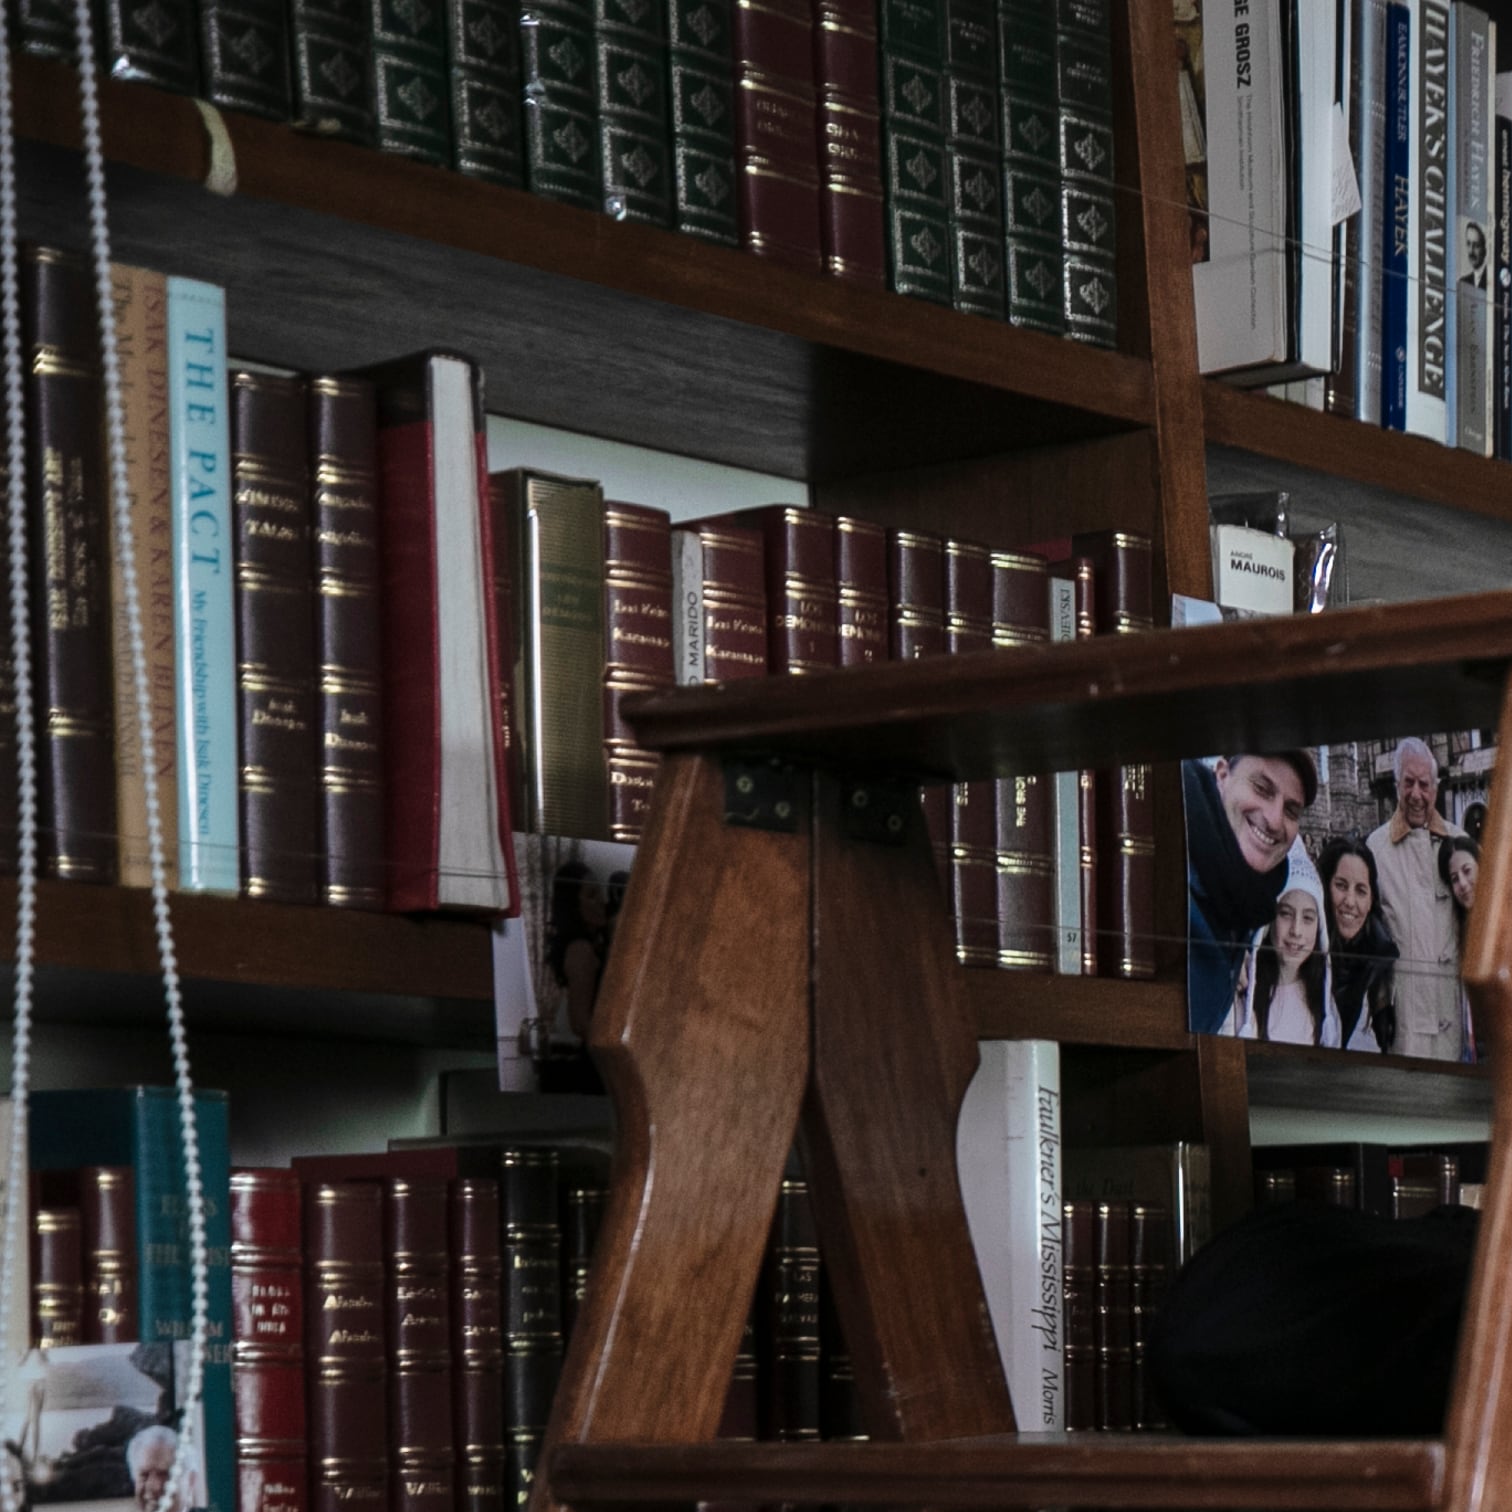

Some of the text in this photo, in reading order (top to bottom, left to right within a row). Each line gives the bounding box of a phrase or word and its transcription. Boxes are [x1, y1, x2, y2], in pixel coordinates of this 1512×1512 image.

[1235, 24, 1252, 89] GROSZ
[1470, 30, 1485, 210] FRIEDRICH HAYEK
[1394, 173, 1408, 256] HAYEK
[1500, 168, 1512, 265] hemingway
[144, 285, 166, 352] ISAK
[1424, 164, 1446, 389] CHALLENGE
[147, 369, 168, 505] DINESEN
[184, 328, 220, 575] THE PACT
[151, 548, 171, 651] KAREN
[1230, 559, 1286, 582] MAUROIS
[688, 592, 699, 666] MARIDO
[153, 664, 173, 779] BLIXEN
[193, 590, 212, 835] My Friendship with Isak Dinesen
[1031, 1086, 1062, 1425] Faulkner's Mississippi Morris
